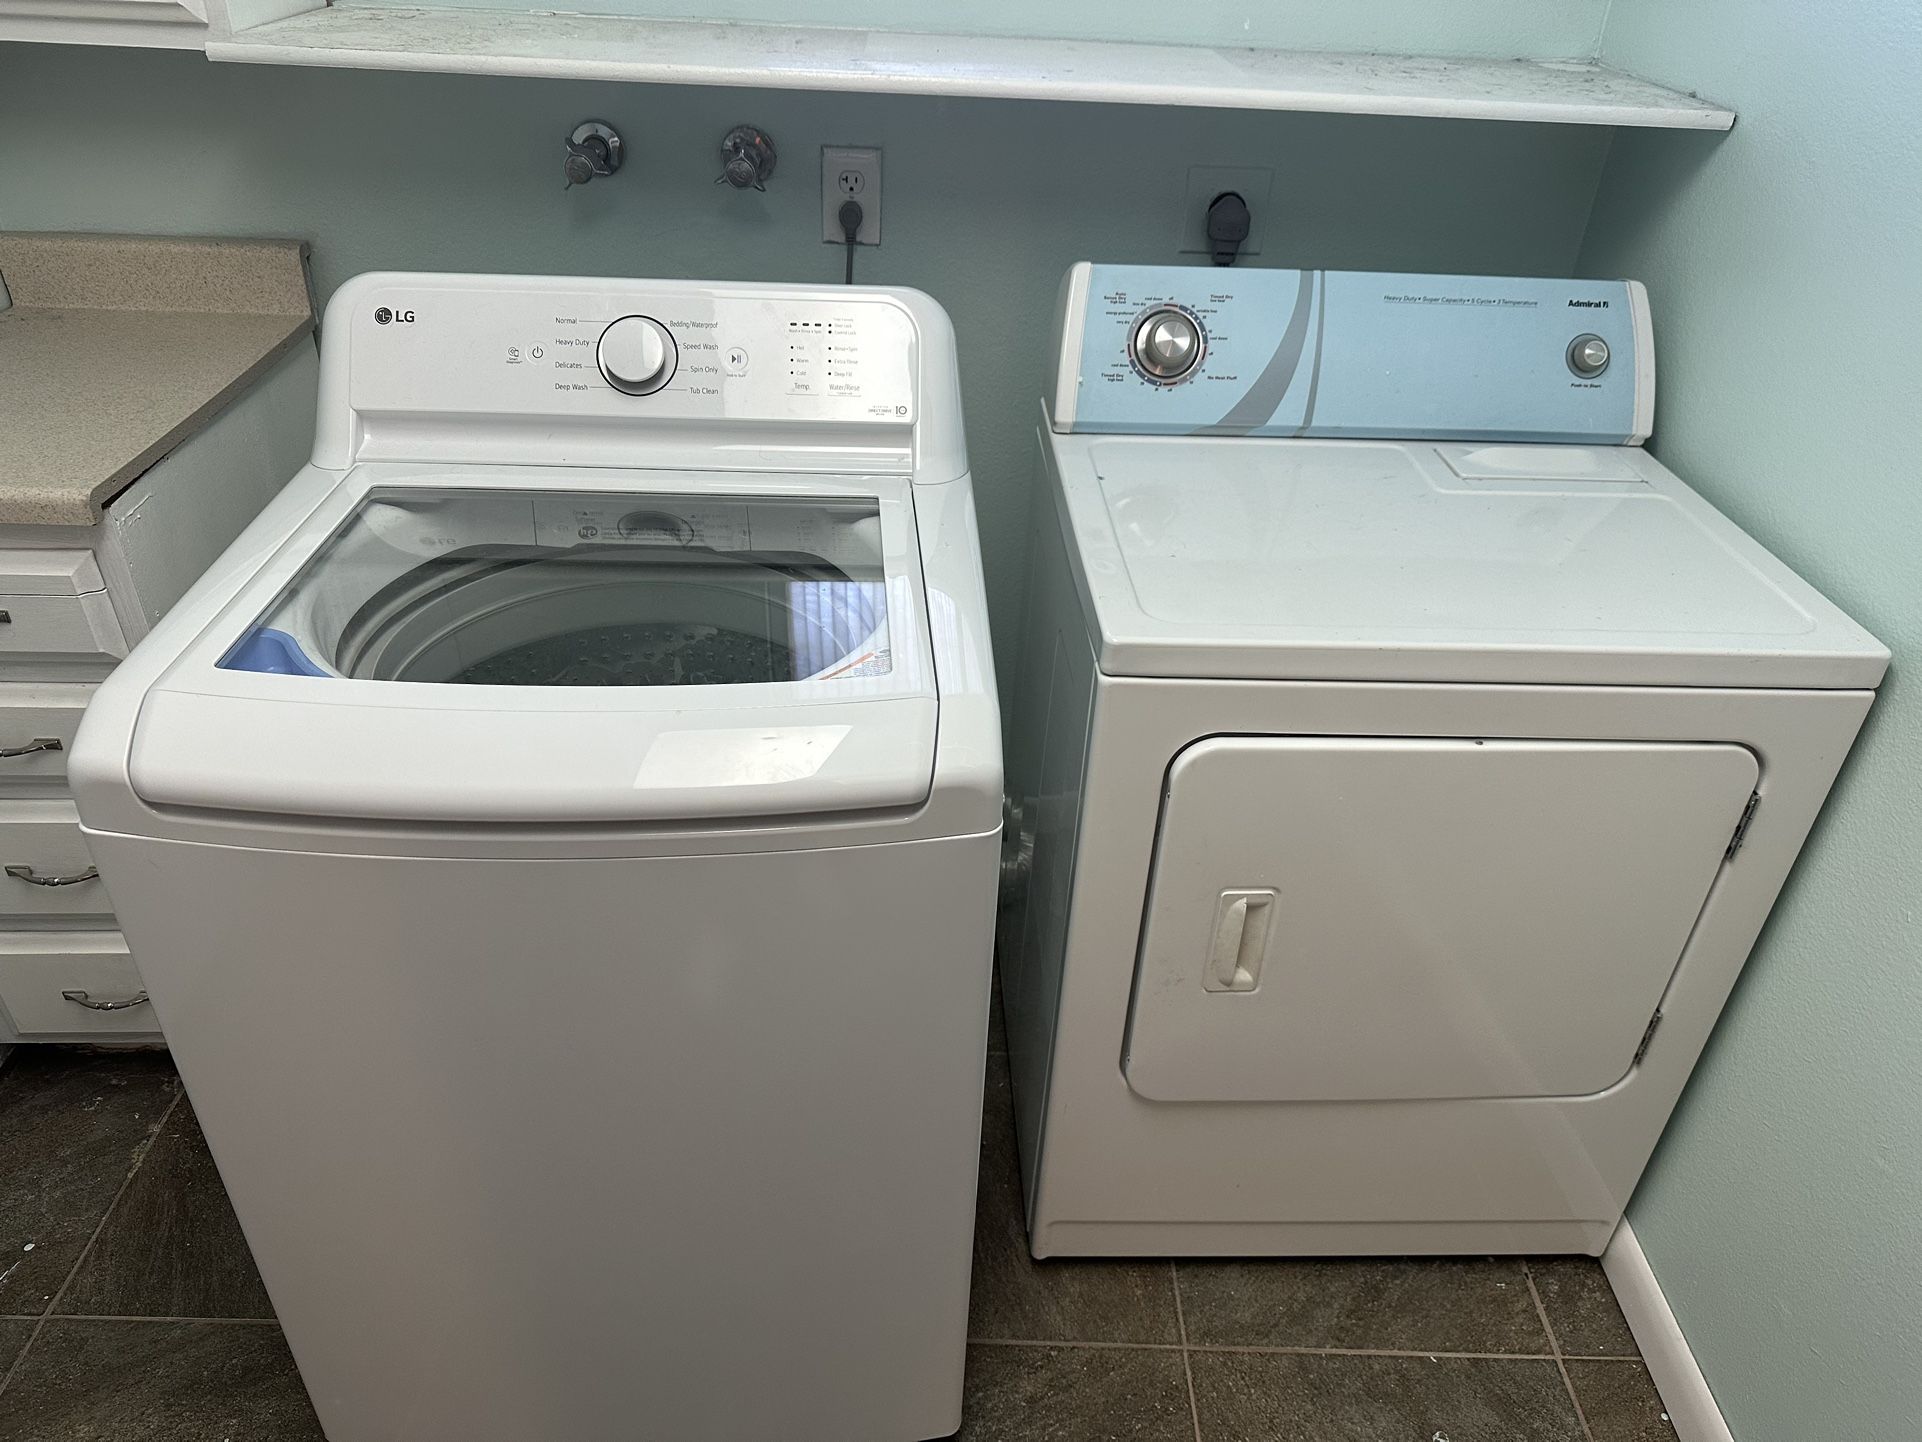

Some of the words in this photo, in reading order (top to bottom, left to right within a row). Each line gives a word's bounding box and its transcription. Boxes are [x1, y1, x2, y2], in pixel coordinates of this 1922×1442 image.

[1568, 299, 1601, 308] Admiral
[395, 311, 415, 322] LG
[669, 320, 718, 329] Bedding/Waterproof
[555, 339, 573, 347] Heavy
[575, 339, 590, 347] Duty
[555, 361, 583, 369] Delicates
[690, 366, 703, 374] Spin
[704, 366, 718, 374] Only
[555, 383, 571, 391] Deep
[572, 383, 588, 391] Wash
